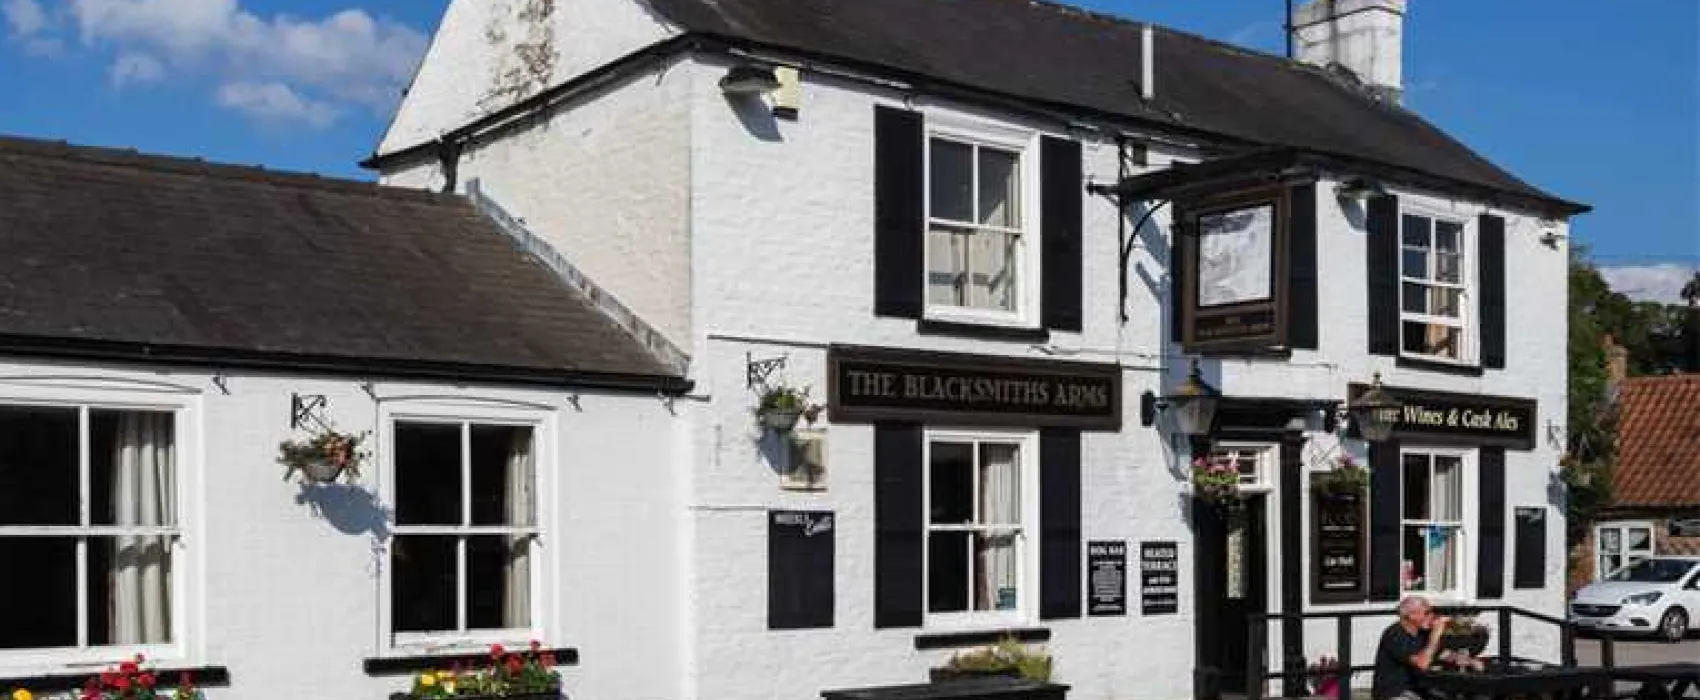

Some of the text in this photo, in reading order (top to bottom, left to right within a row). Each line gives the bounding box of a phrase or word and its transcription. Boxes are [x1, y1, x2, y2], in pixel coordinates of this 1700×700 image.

[848, 370, 1108, 408] THE BLACKSMITHS ARMS
[1404, 404, 1443, 425] Wines
[1447, 407, 1458, 427] &
[1462, 408, 1492, 429] Cask
[1494, 411, 1519, 431] Ales
